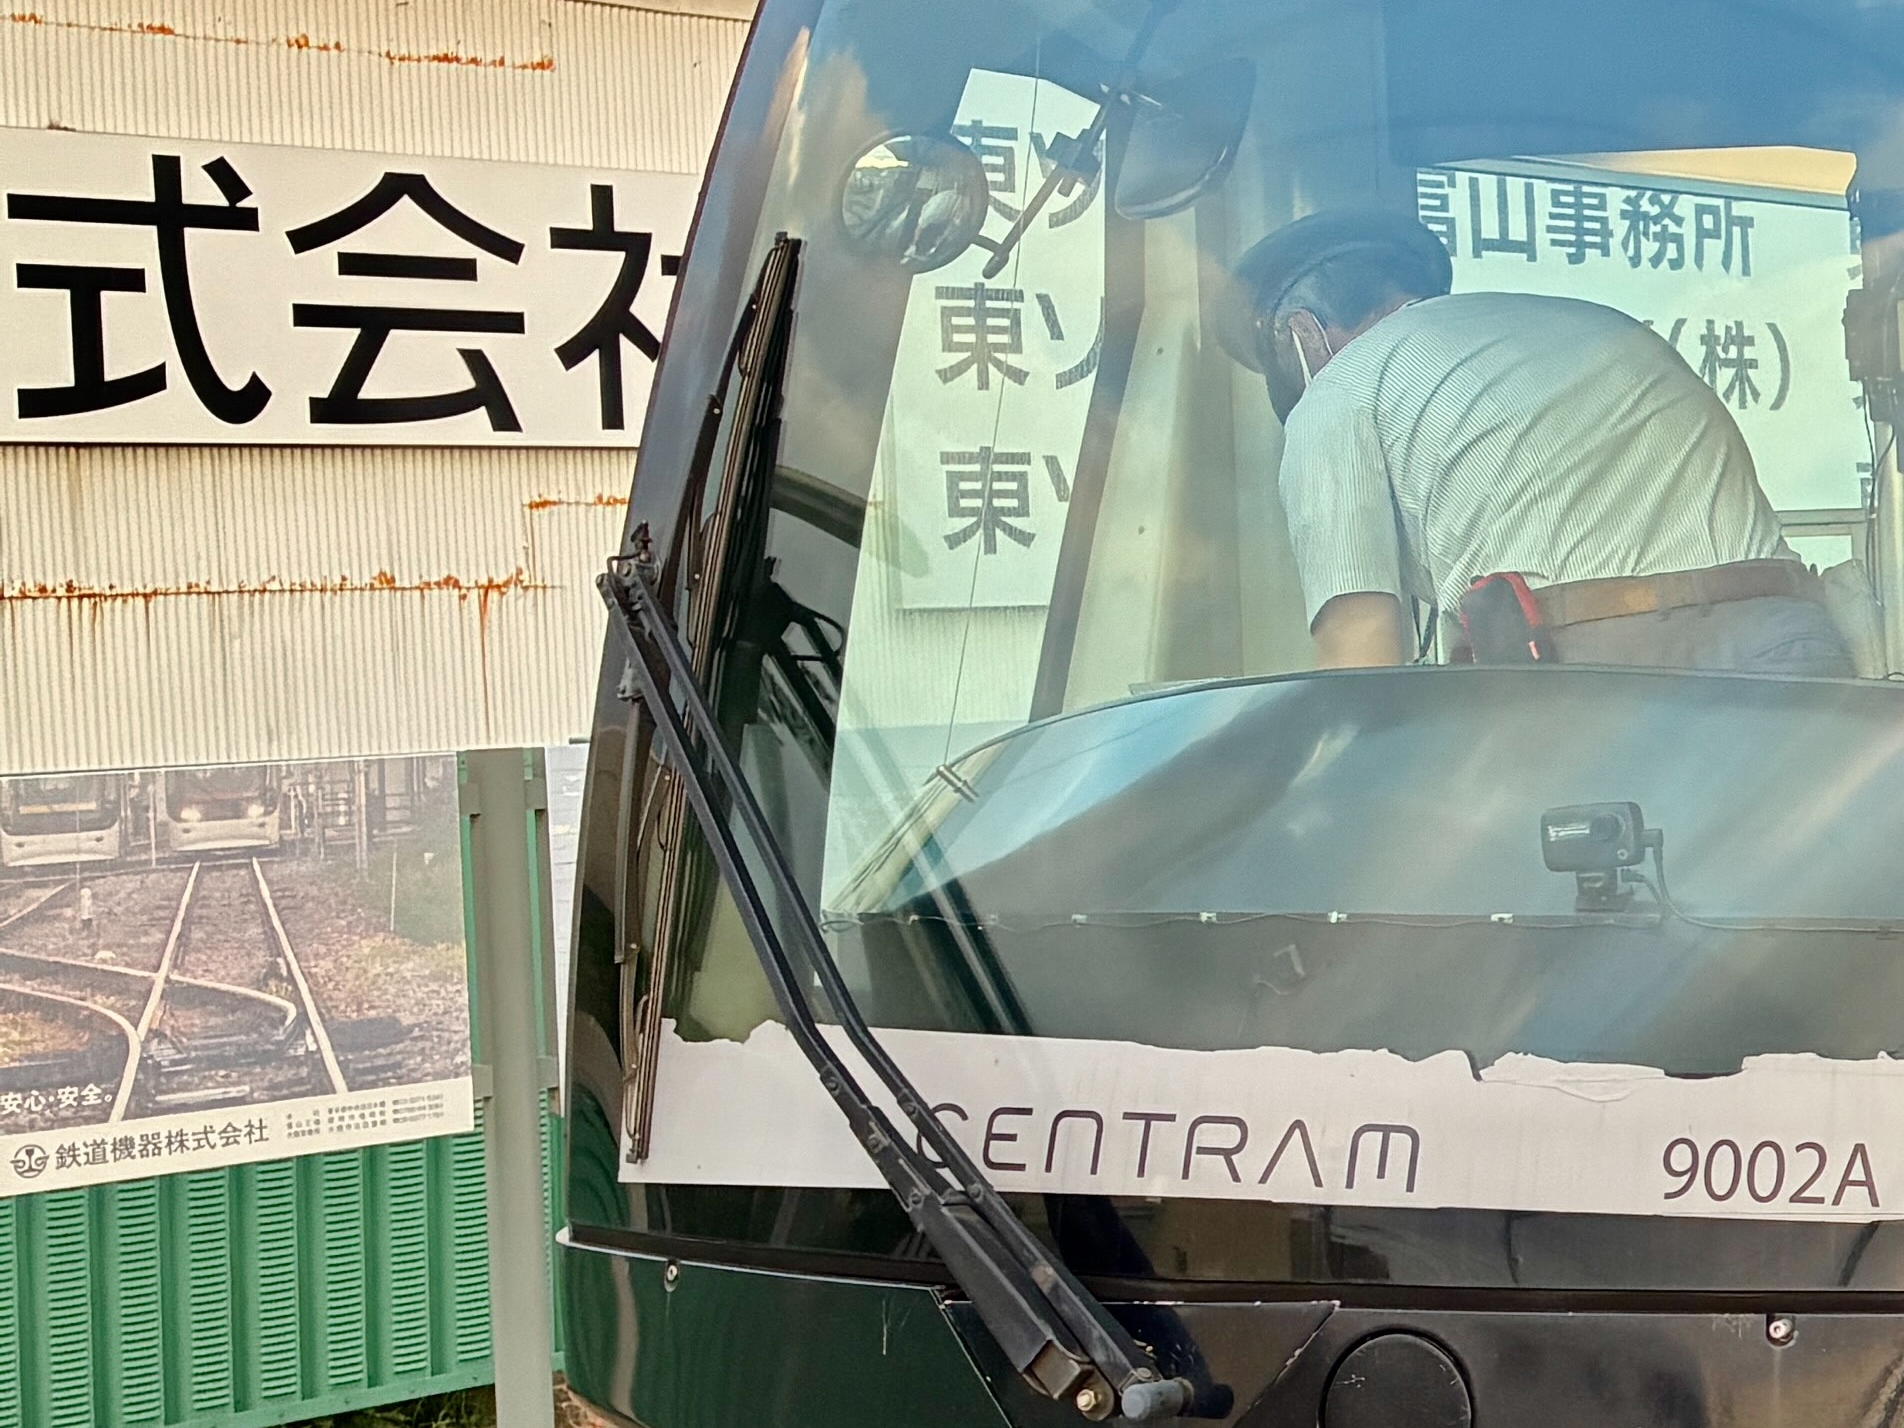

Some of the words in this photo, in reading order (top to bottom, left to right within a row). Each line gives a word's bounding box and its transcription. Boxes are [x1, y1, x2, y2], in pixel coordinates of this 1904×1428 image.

[55, 1117, 271, 1171] 鉄道機器株式会社
[916, 1102, 1421, 1194] CENTRAM
[1662, 1136, 1881, 1210] 9002A
